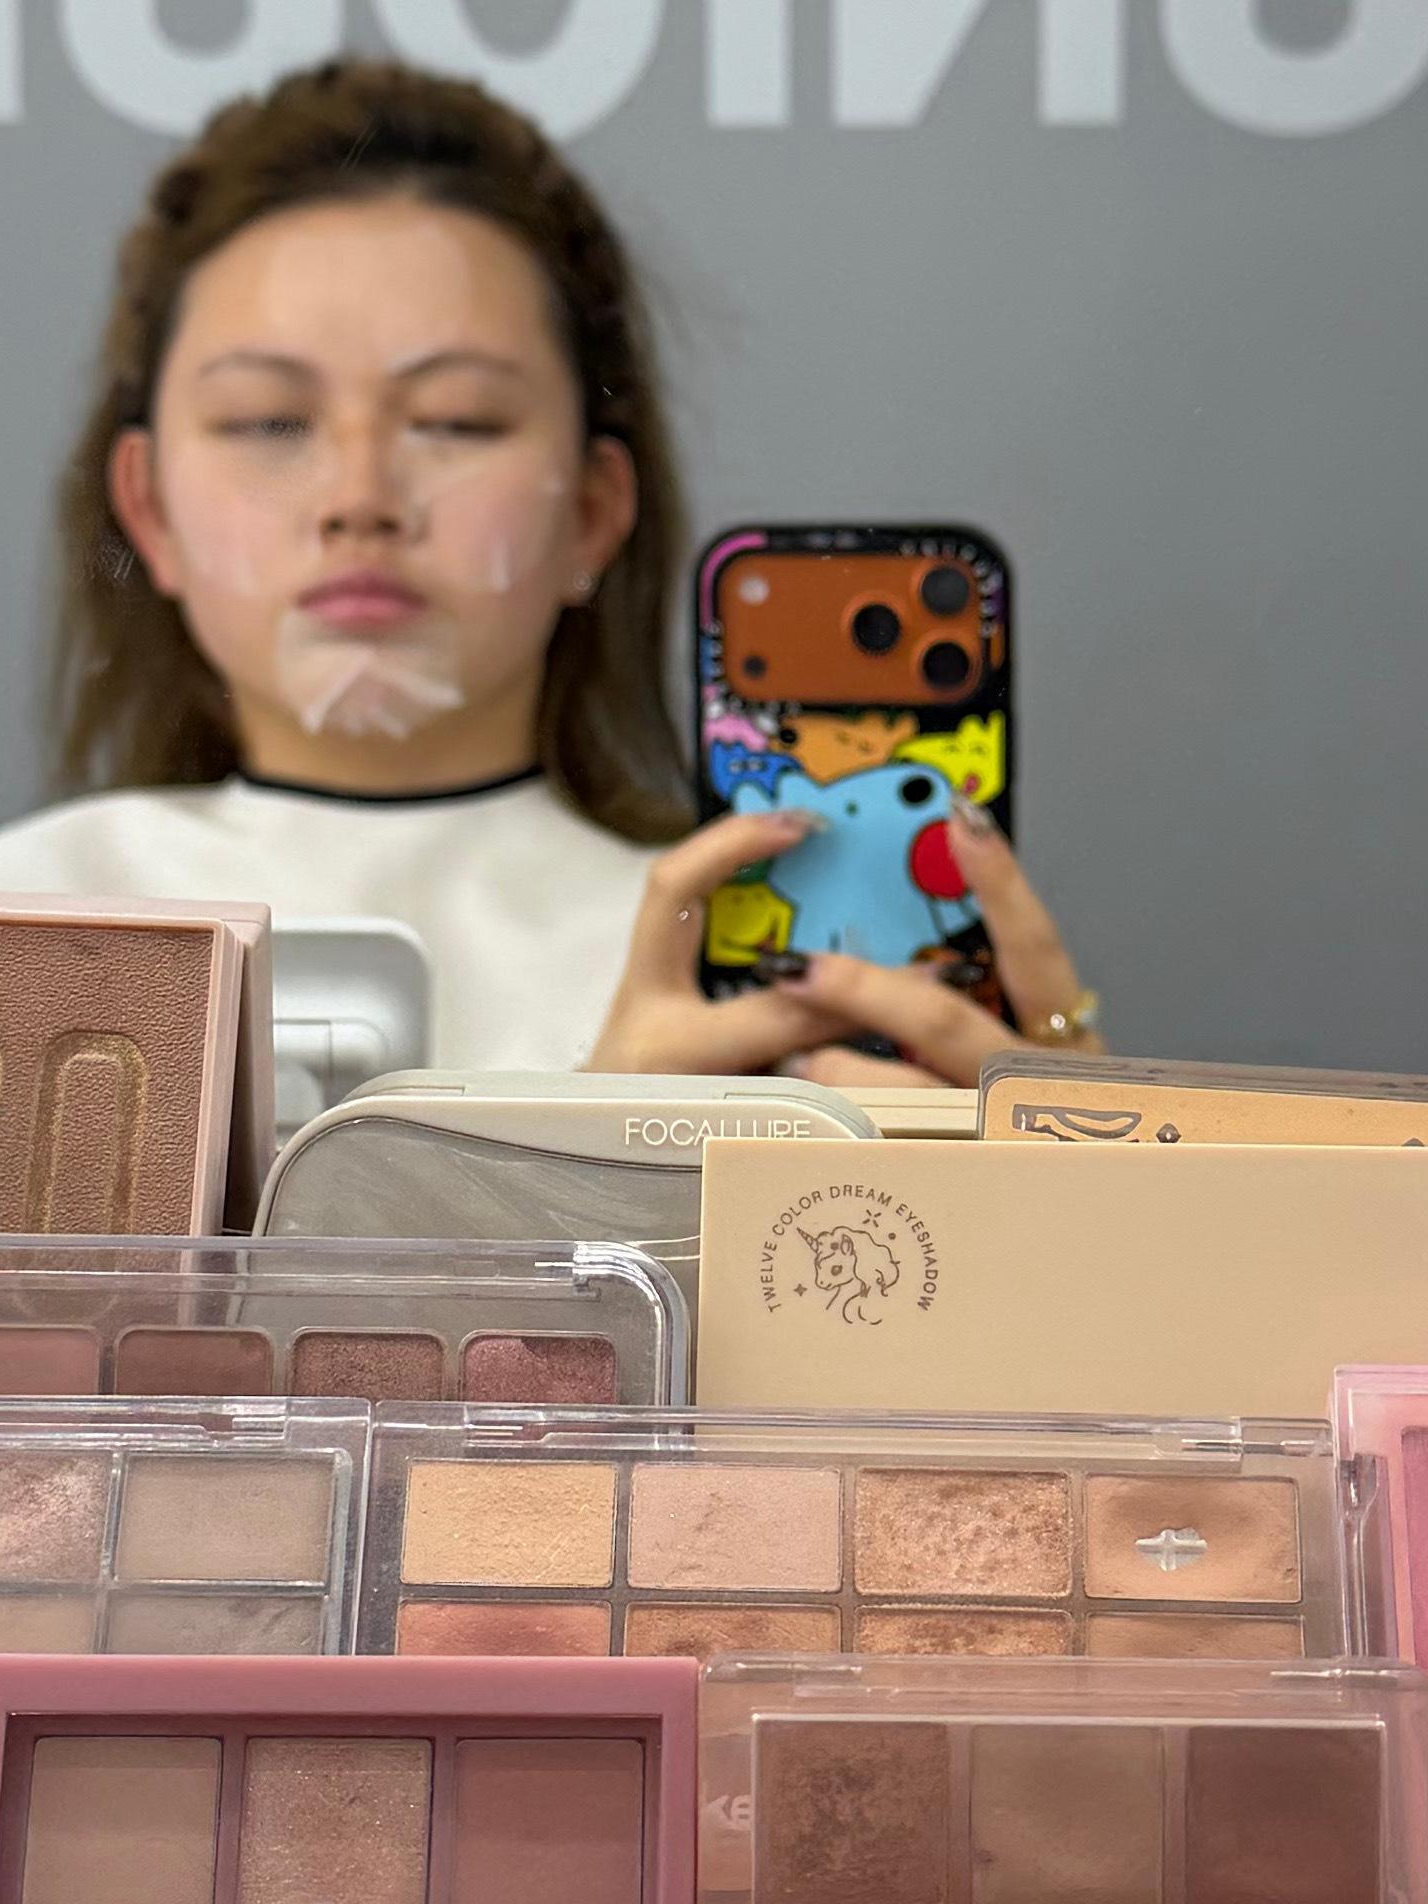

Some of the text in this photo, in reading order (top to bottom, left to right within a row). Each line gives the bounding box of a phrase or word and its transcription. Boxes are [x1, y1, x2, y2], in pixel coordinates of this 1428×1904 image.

[760, 1184, 939, 1314] TWELVE COLOR DREAM EYESHADOW
